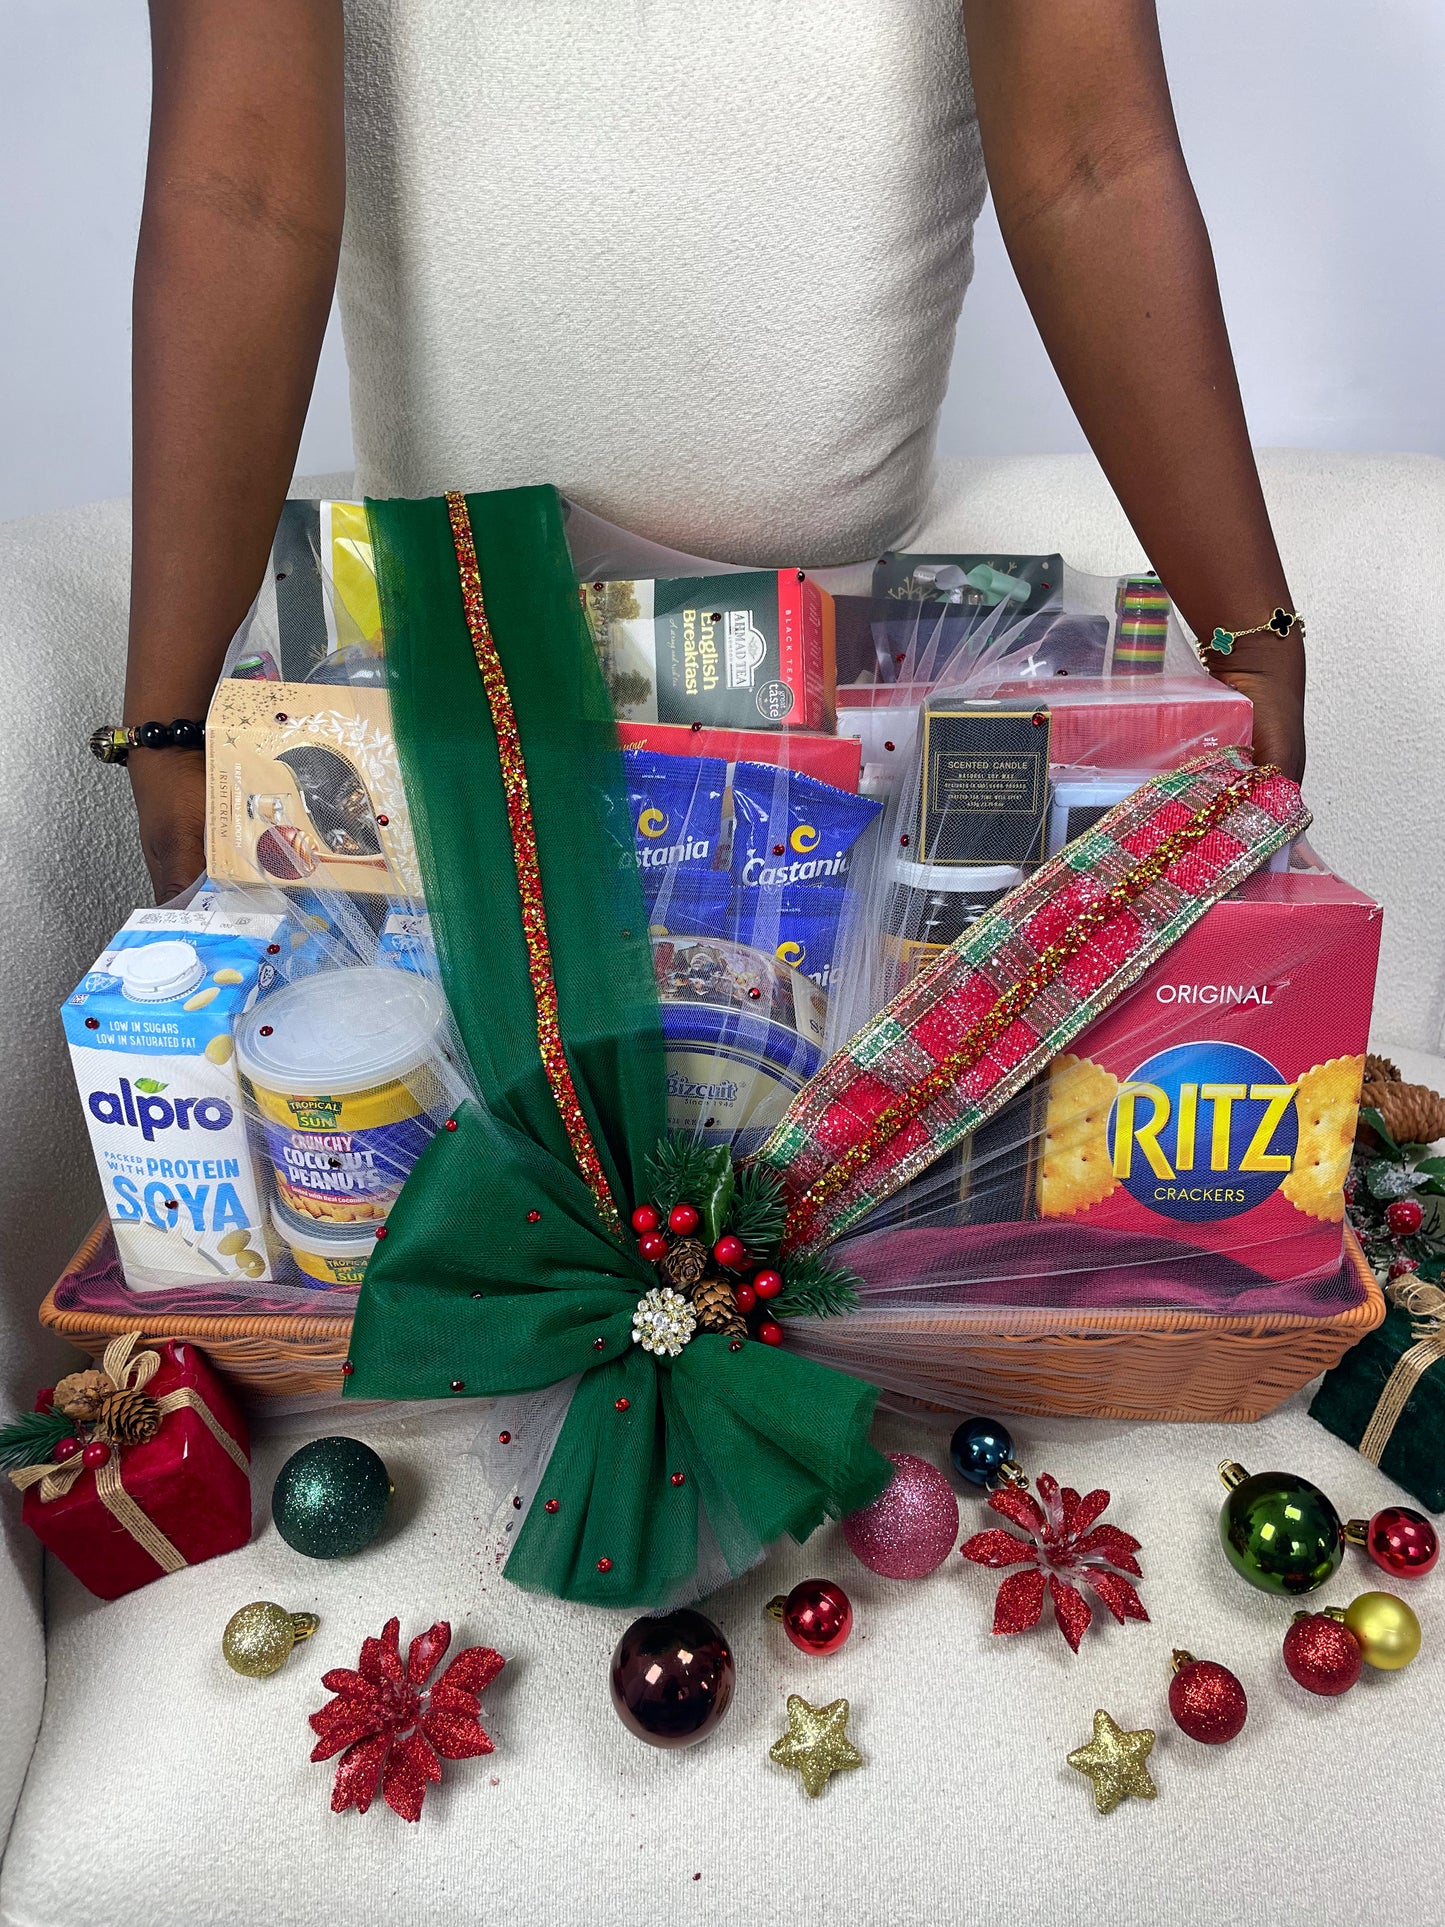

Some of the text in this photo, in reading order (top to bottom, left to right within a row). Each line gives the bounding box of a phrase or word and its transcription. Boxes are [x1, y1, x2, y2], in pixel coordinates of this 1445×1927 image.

[683, 609, 698, 695] Breakfast
[699, 612, 719, 691] English
[734, 613, 747, 685] AHMAD TEA
[769, 683, 779, 718] taste
[778, 690, 786, 709] great
[947, 761, 1028, 769] SCENTED CANDLE
[219, 770, 229, 838] IRISH CREAM
[234, 813, 242, 848] SMOOTH
[626, 835, 709, 868] stania
[742, 851, 850, 888] Castania
[1155, 984, 1274, 1005] ORIGINAL
[109, 1021, 179, 1034] LOW IN SUGARS
[96, 1033, 196, 1048] LOW IN SATURATED FAT
[88, 1077, 234, 1142] alpro
[289, 1101, 341, 1112] TROPICAL
[300, 1116, 334, 1127] SUN
[1112, 1081, 1300, 1180] RITZ
[291, 1133, 353, 1152] CRUNCHY
[104, 1151, 143, 1164] PACKED
[106, 1157, 240, 1179] WITH PROTEIN
[287, 1166, 380, 1190] PEANUTS
[112, 1175, 251, 1232] SOYA
[309, 1192, 323, 1200] with
[323, 1195, 337, 1203] Real
[1153, 1187, 1246, 1203] CRACKERS
